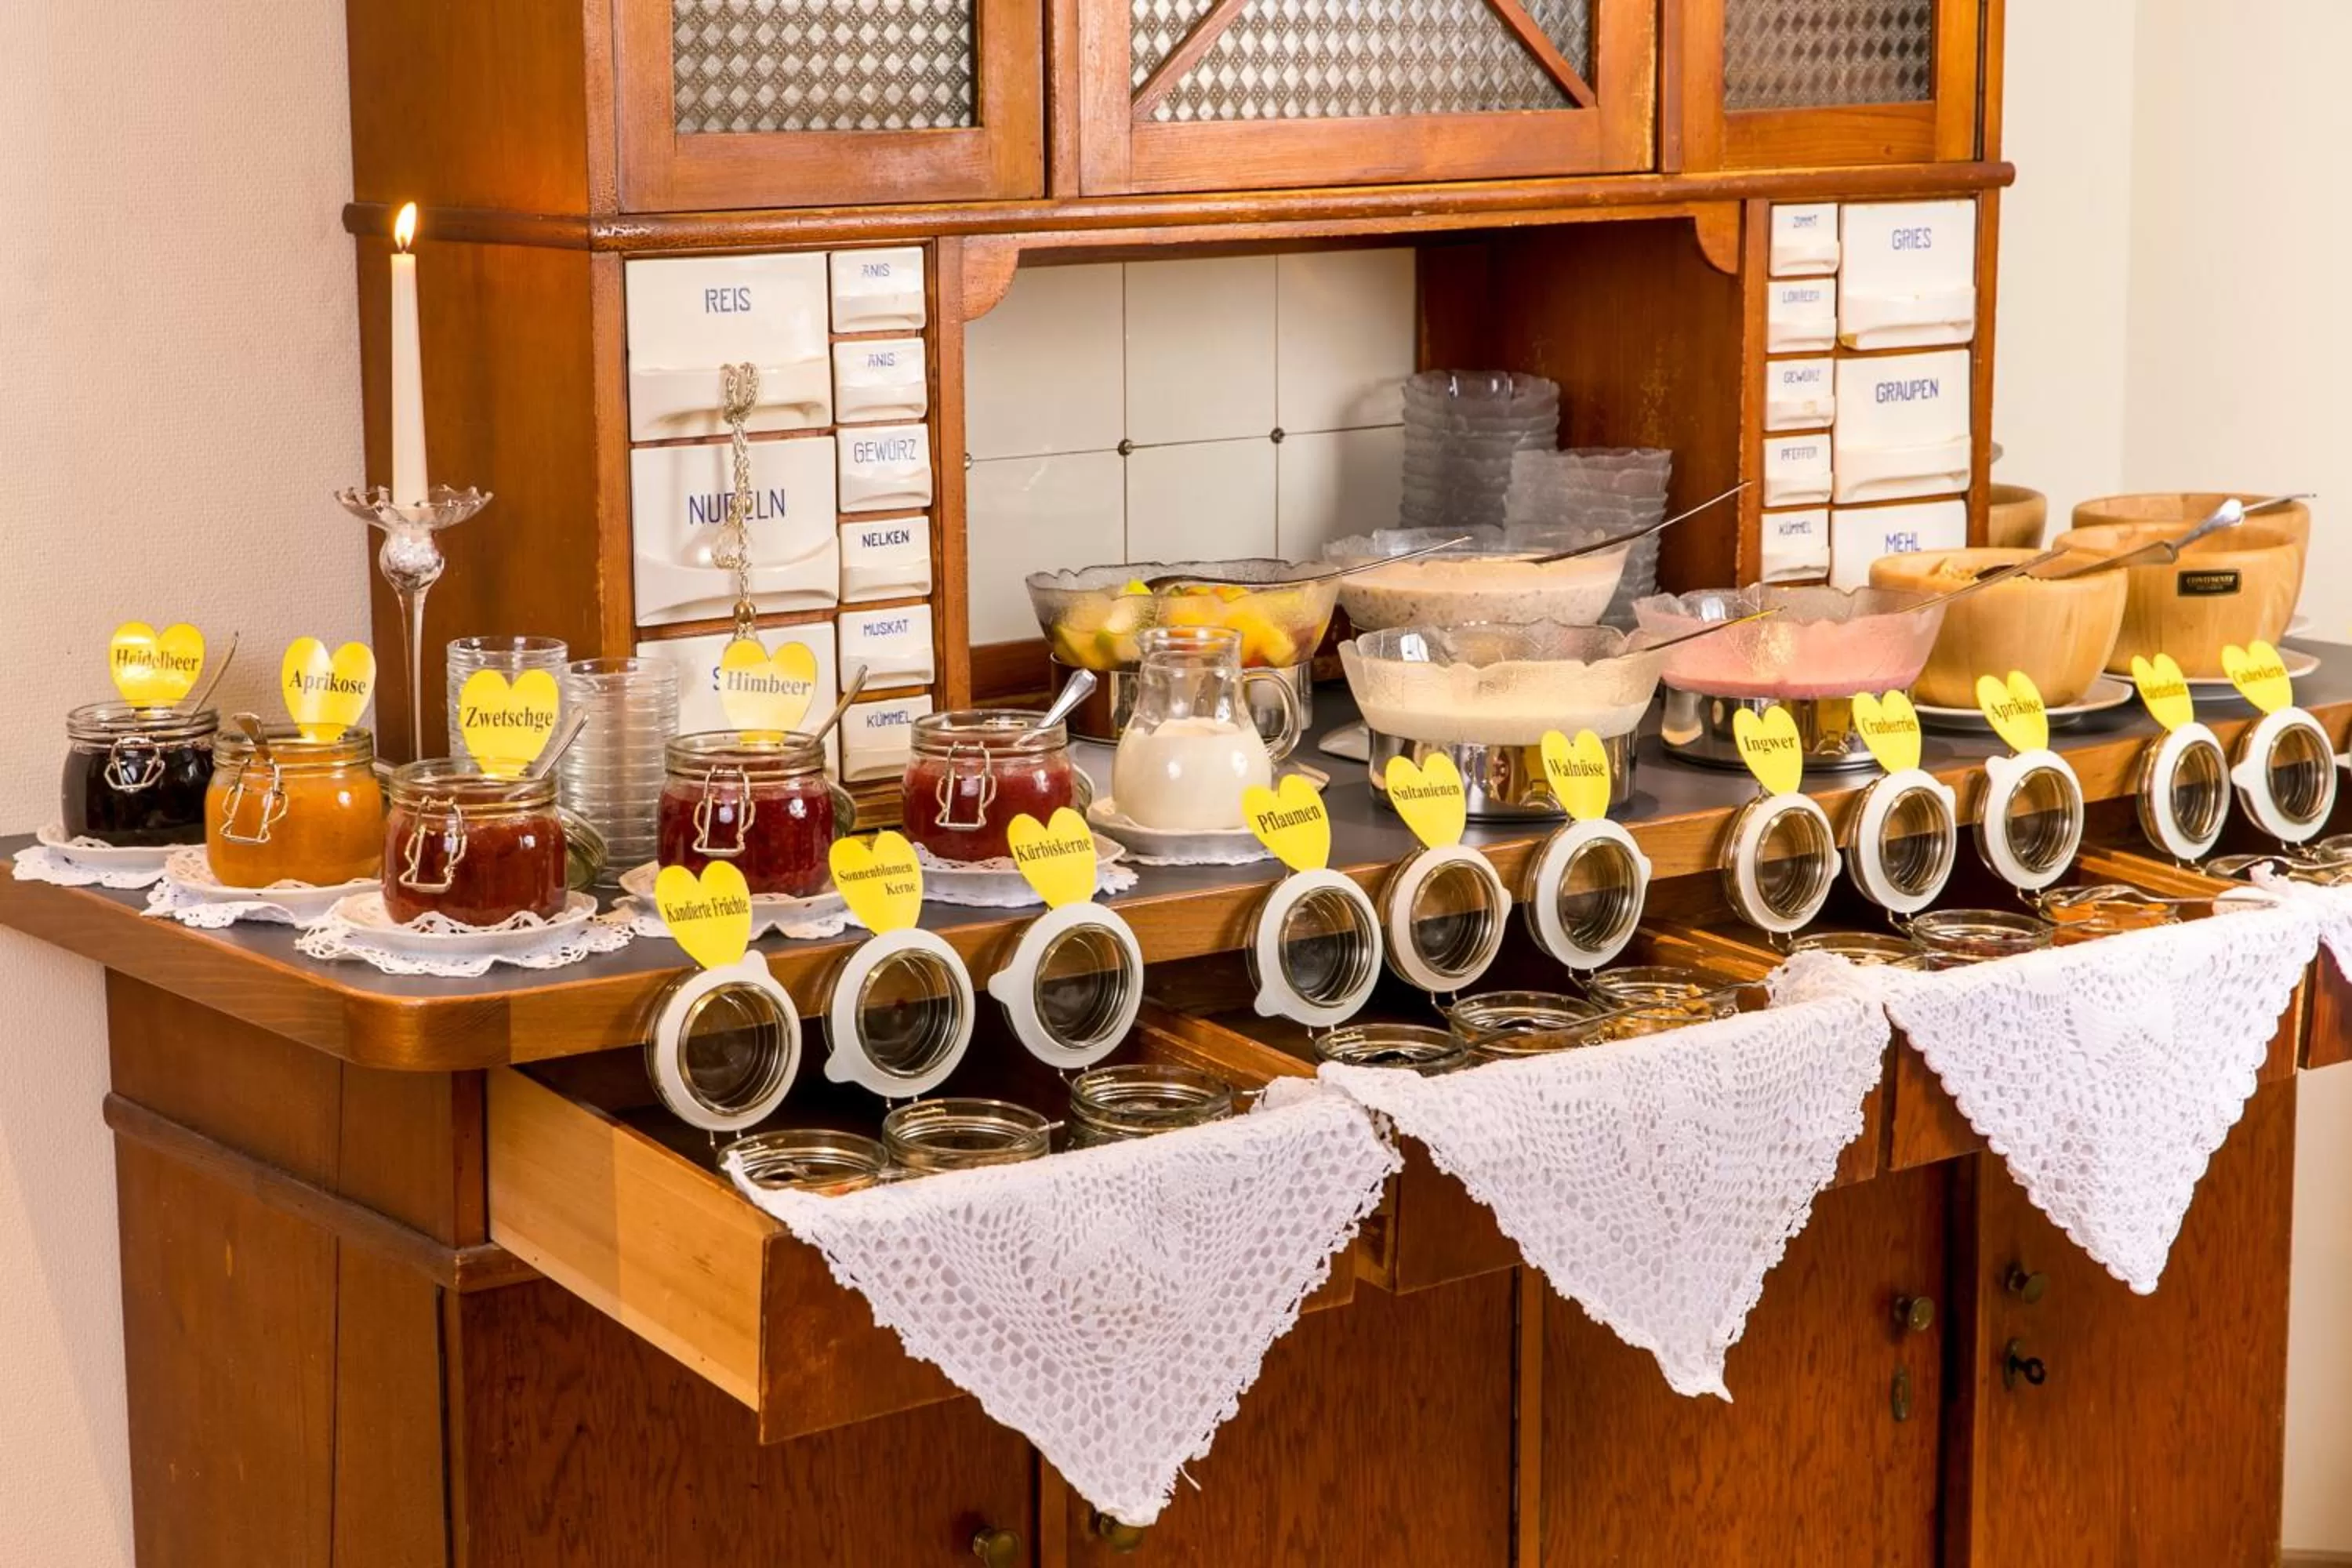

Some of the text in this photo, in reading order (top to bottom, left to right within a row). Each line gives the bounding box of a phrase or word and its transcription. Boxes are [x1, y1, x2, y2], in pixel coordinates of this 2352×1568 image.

[1892, 227, 1932, 249] GRIES
[862, 263, 890, 278] ANIS
[705, 287, 751, 313] REIS
[867, 353, 895, 367] ANIS
[1875, 379, 1939, 403] GRAUPEN
[853, 438, 916, 463] GEWÜRZ
[862, 529, 909, 547] NELKEN
[1885, 532, 1922, 554] MEHL
[863, 619, 909, 637] MUSKAT
[115, 648, 200, 672] Heidelbeer
[289, 670, 366, 695] Aprikose
[727, 671, 811, 695] Himbeer
[466, 706, 554, 733] Zwetschge
[866, 710, 913, 728] KÜMMEL
[1989, 697, 2042, 723] Aprikose
[1744, 735, 1795, 753] Ingwer
[1548, 758, 1606, 778] Walnüsse
[1257, 804, 1321, 834] Pflaumen
[1014, 837, 1092, 863] Kürbiskerne
[837, 862, 913, 884] Sonnenblumen
[884, 881, 916, 897] Kerne
[664, 895, 749, 924] Kandierte Früchte
